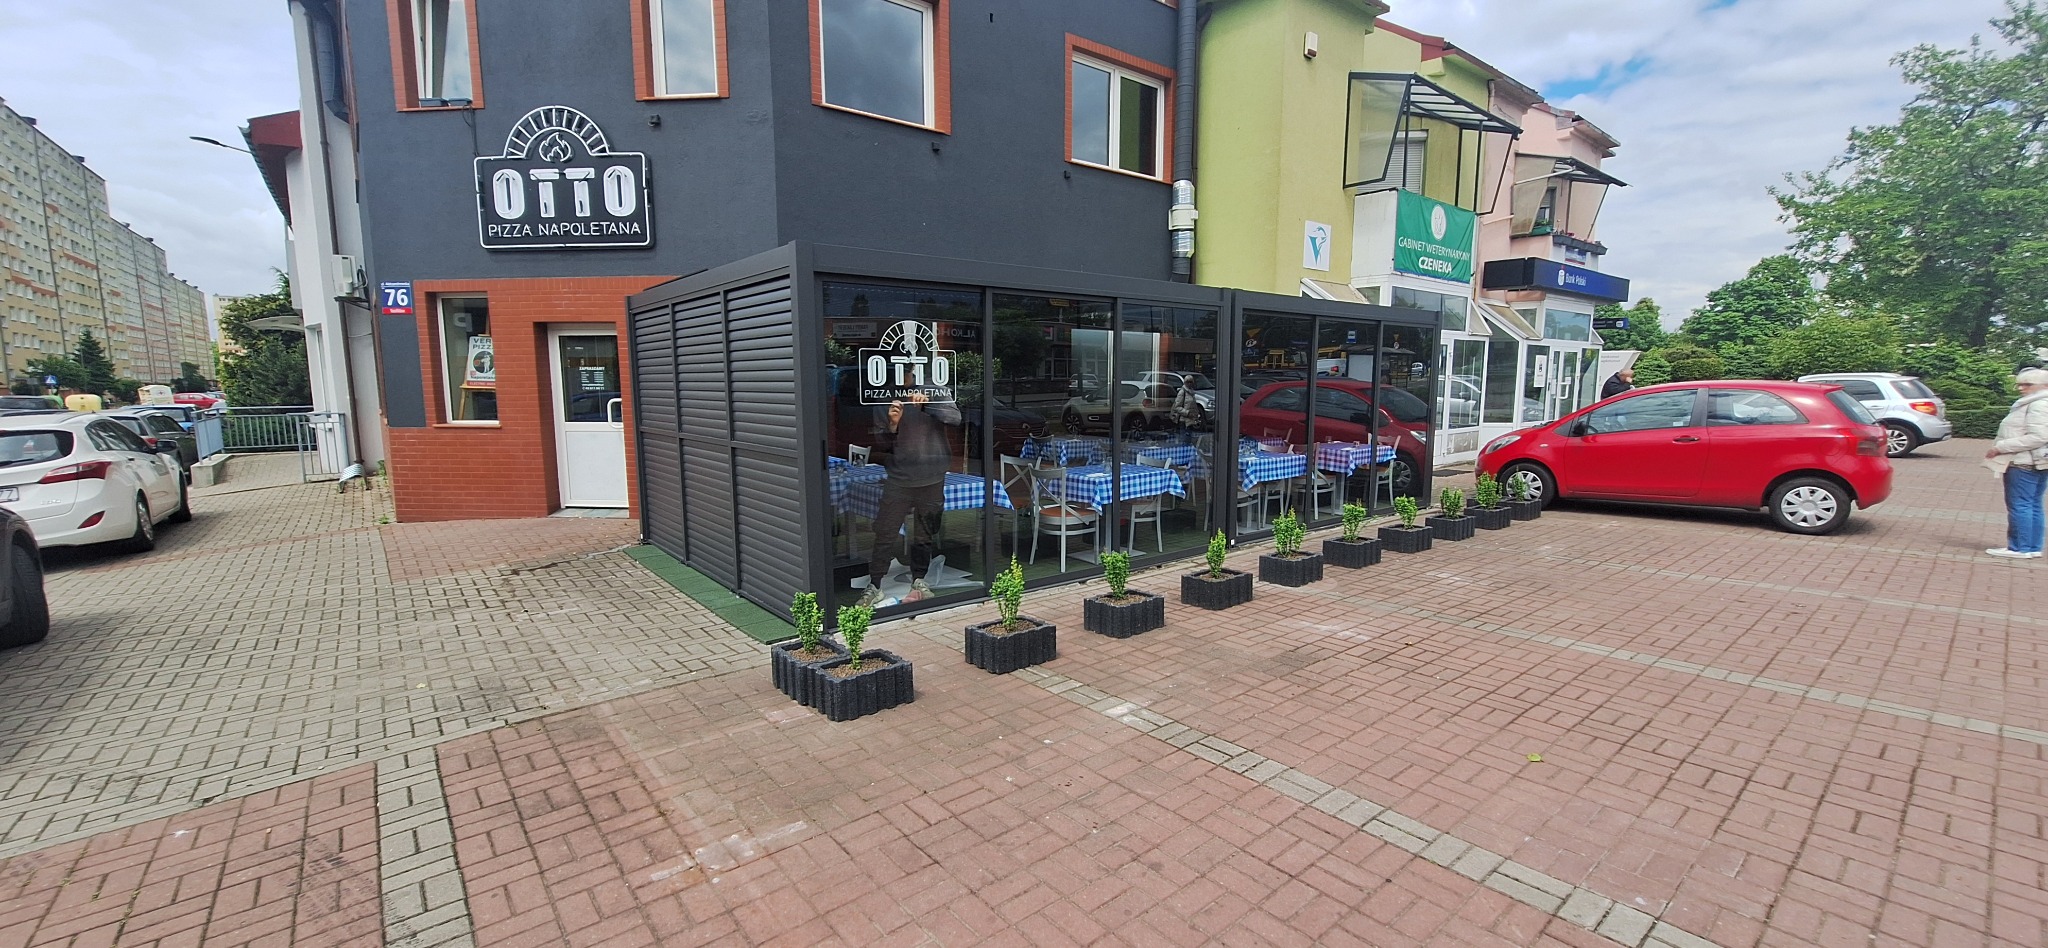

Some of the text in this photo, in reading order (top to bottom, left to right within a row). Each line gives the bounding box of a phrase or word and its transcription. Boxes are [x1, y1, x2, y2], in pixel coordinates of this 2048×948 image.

[493, 165, 636, 219] OTTO
[489, 222, 641, 237] PIZZA NAPOLETANA
[1398, 236, 1471, 260] GABINET WETERYNARYJNY
[1418, 256, 1452, 273] CZENEKA
[1565, 273, 1587, 287] Bank Polski
[384, 288, 409, 306] 76
[867, 355, 950, 387] OTTO
[864, 388, 952, 398] PIZZA NAPOLETANA
